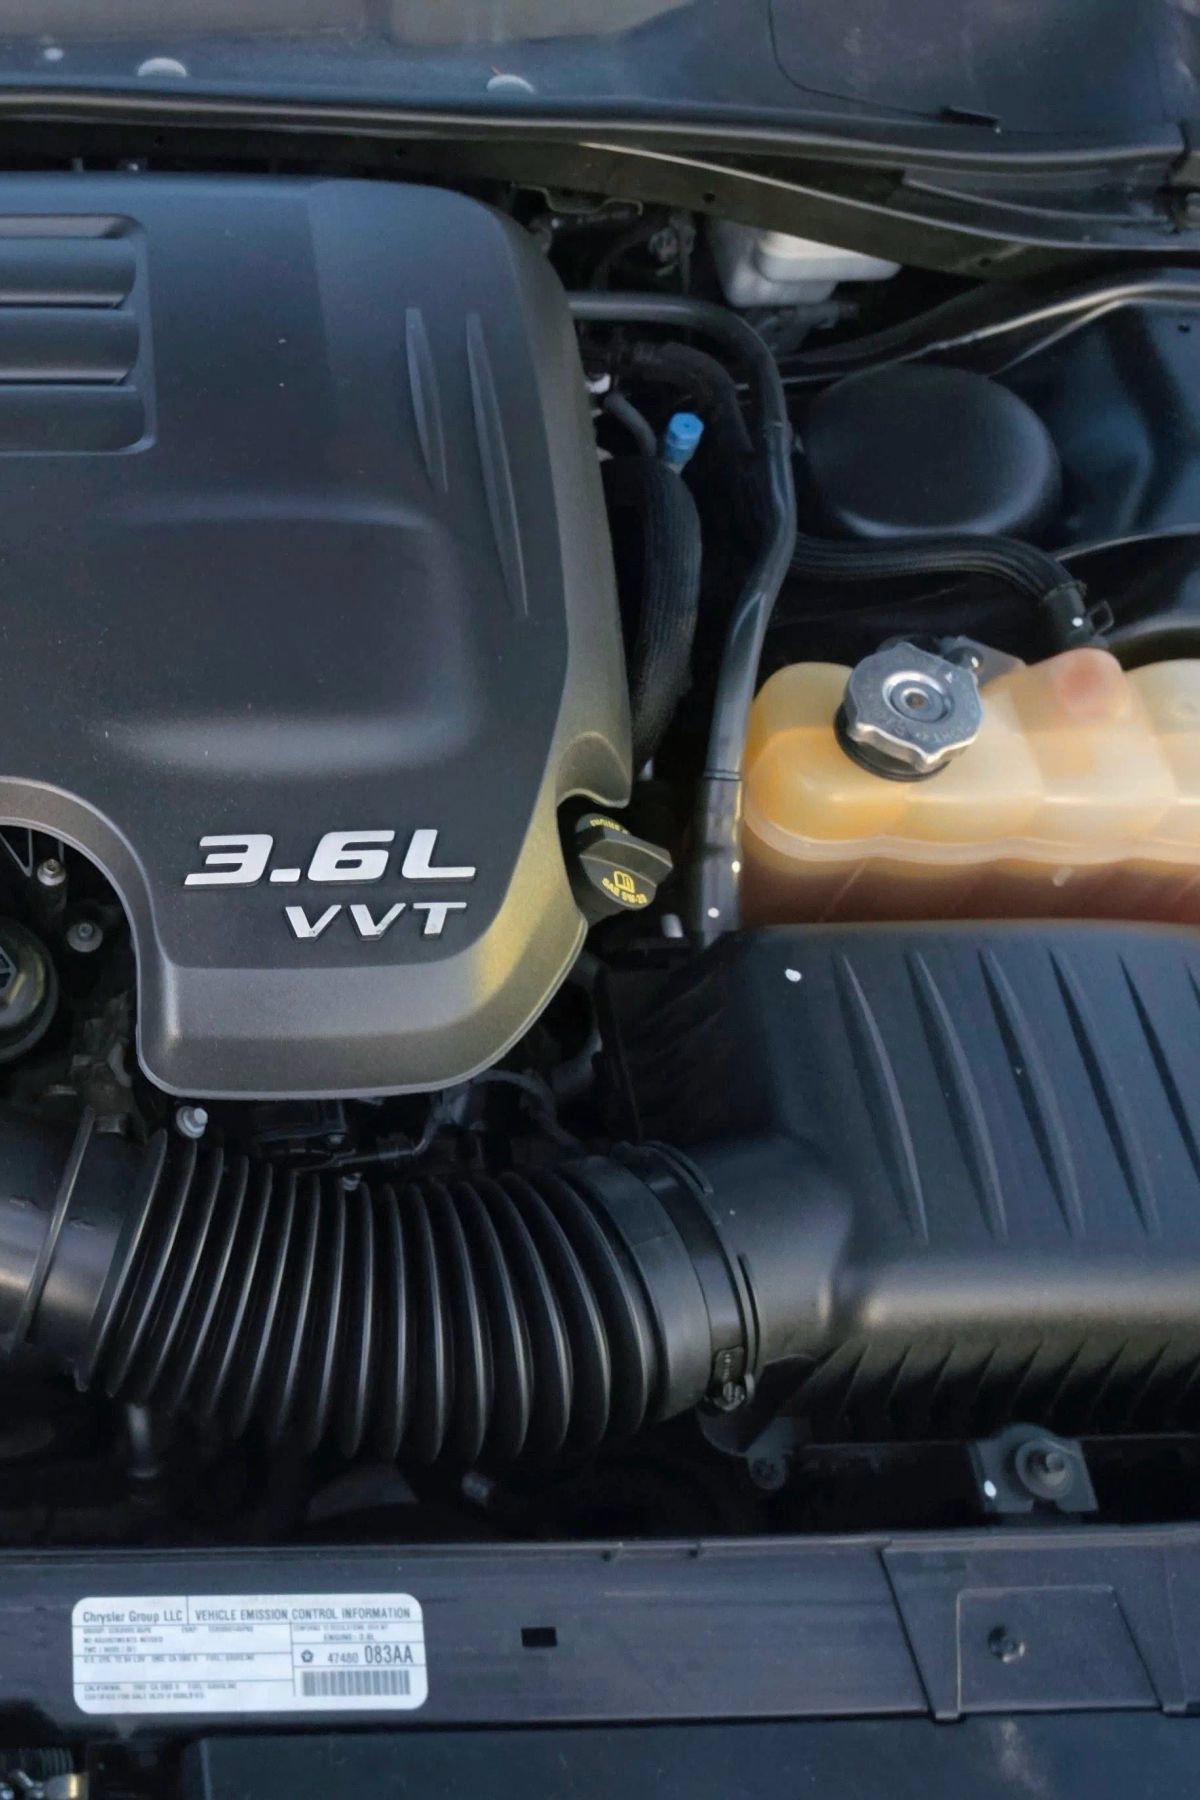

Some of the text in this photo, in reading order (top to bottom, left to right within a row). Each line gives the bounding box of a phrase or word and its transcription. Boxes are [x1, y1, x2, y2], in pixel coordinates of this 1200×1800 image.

[184, 829, 476, 887] 3.6L
[284, 902, 468, 940] VVT
[83, 1609, 183, 1625] Chrysler Group LLC
[195, 1607, 411, 1621] VEHICLE EMISSION CONTROL INFORMATION
[364, 1644, 414, 1664] 083AA
